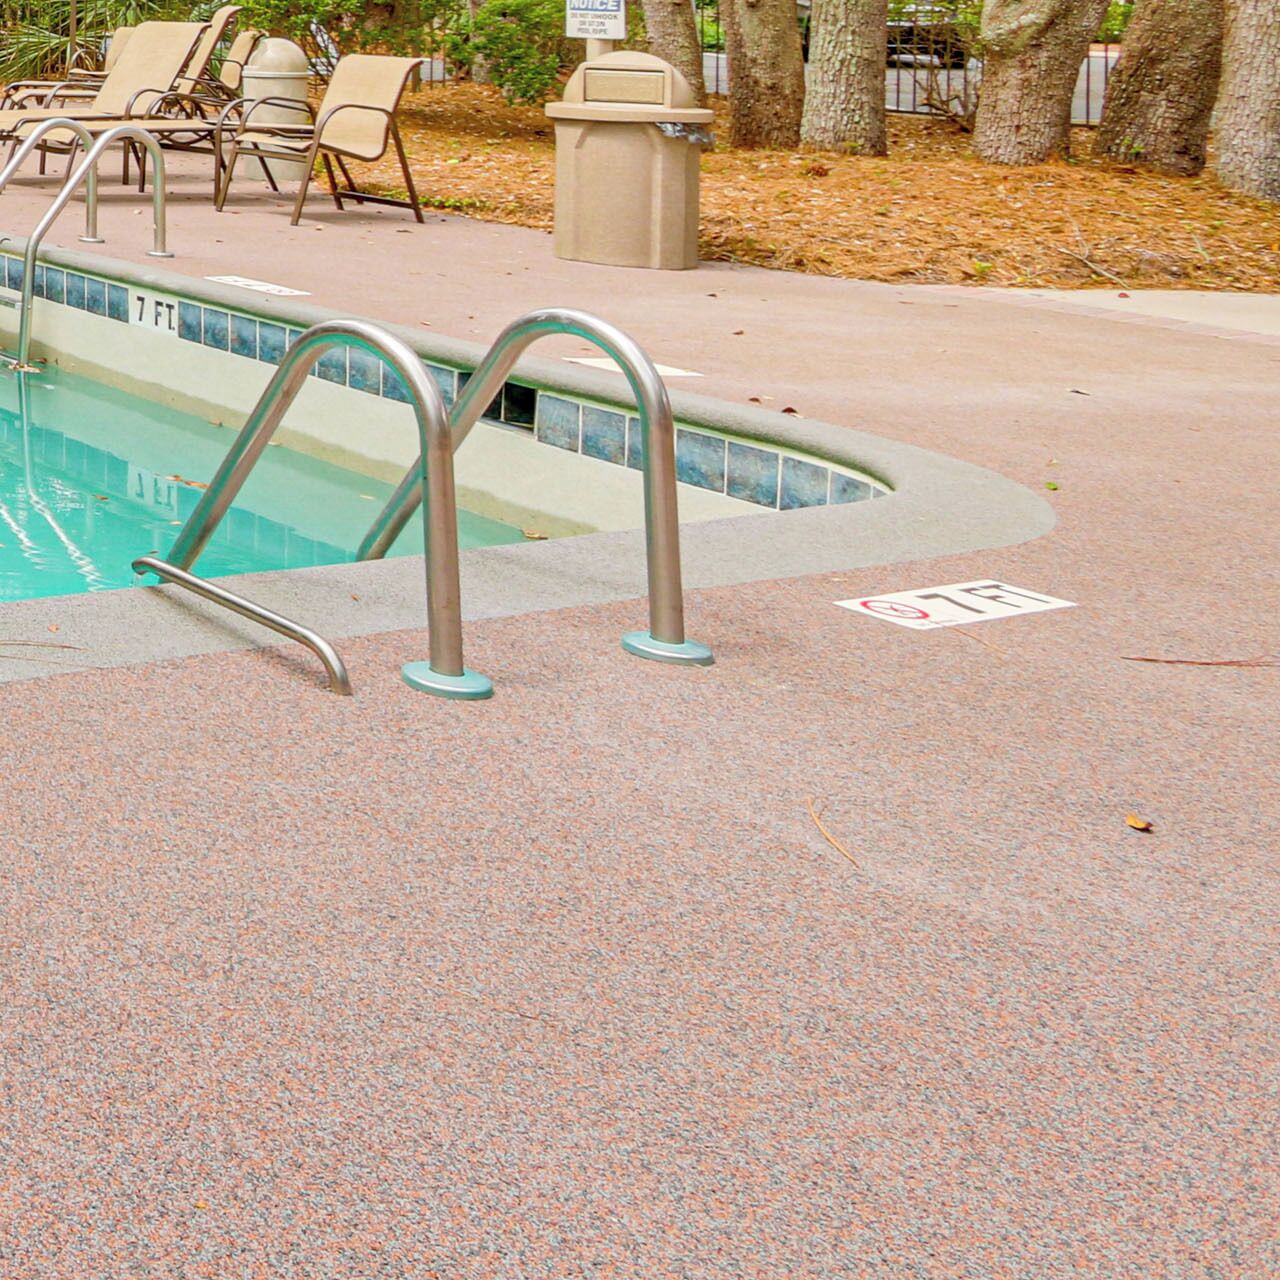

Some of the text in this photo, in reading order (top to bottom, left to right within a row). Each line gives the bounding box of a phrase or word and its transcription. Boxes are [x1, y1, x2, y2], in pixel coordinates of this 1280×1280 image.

[136, 295, 145, 322] 7
[914, 584, 1051, 614] 7 FT
